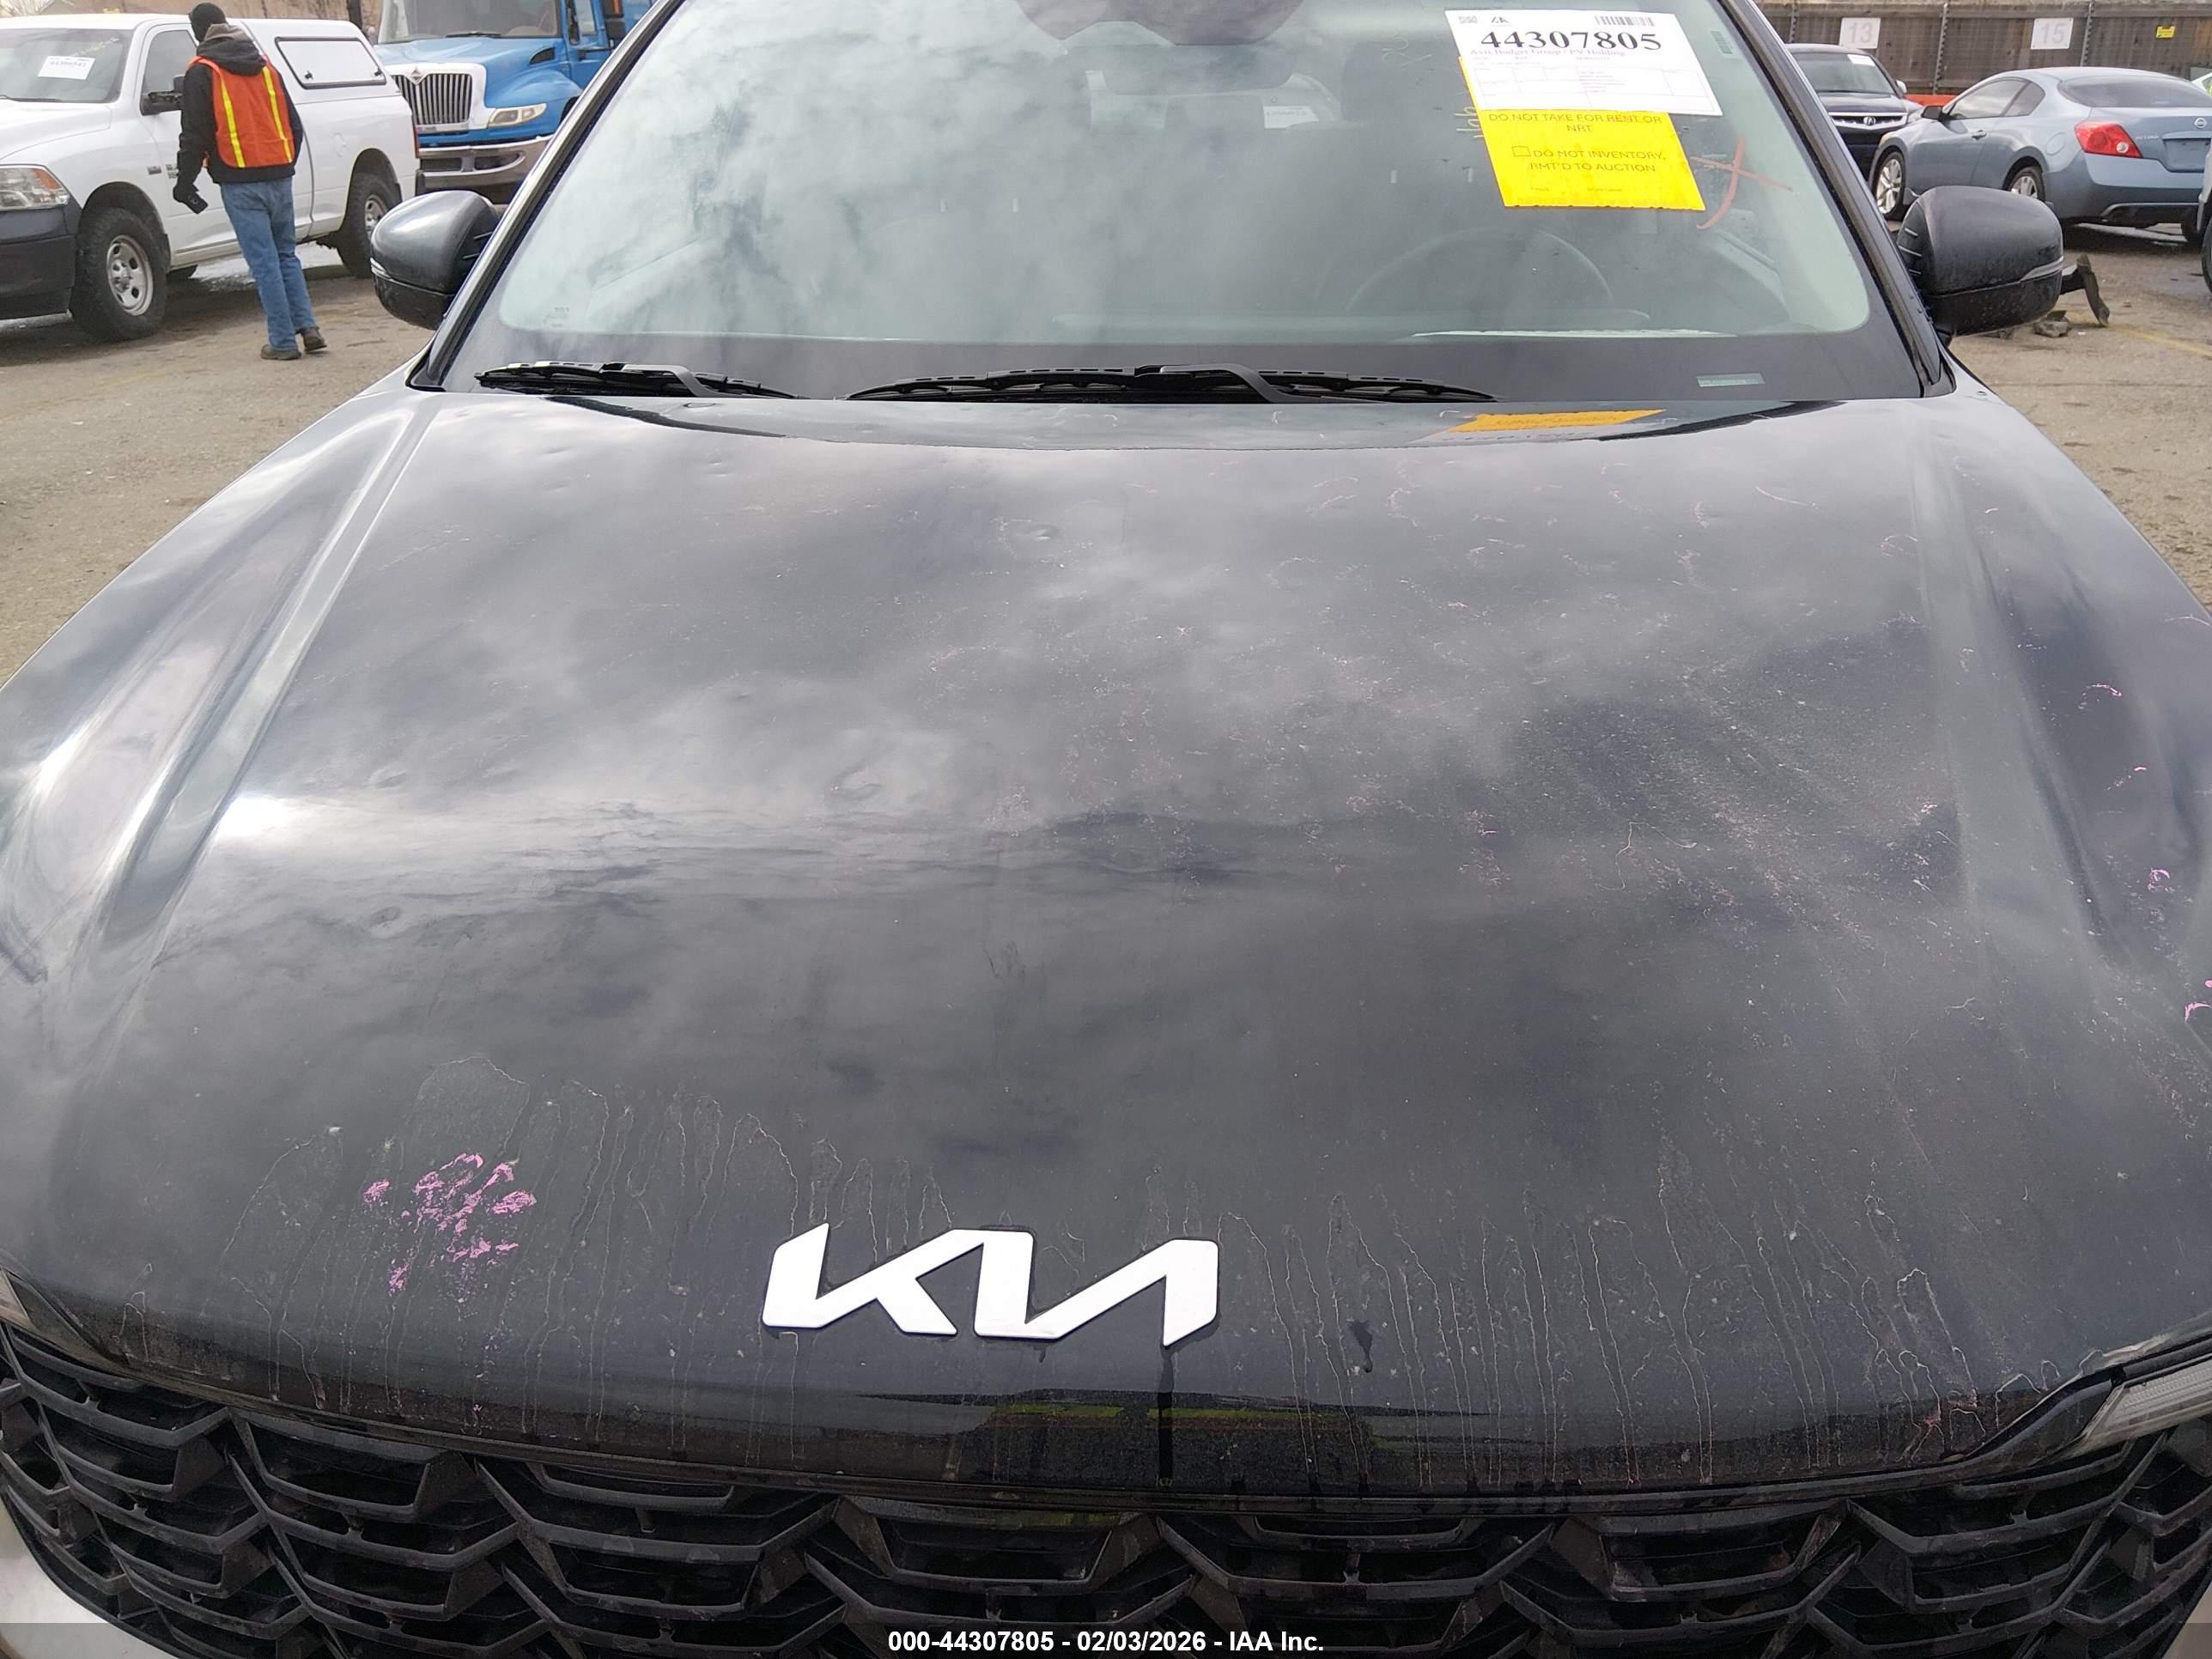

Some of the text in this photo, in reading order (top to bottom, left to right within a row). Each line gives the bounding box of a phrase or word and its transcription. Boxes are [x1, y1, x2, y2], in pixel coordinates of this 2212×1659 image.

[1480, 31, 1662, 51] 44307805
[1848, 21, 1873, 43] 13
[2041, 22, 2067, 44] 15
[1489, 113, 1662, 125] DO NOT TAKE FOR RENT OR
[1596, 163, 1656, 172] AUCTION
